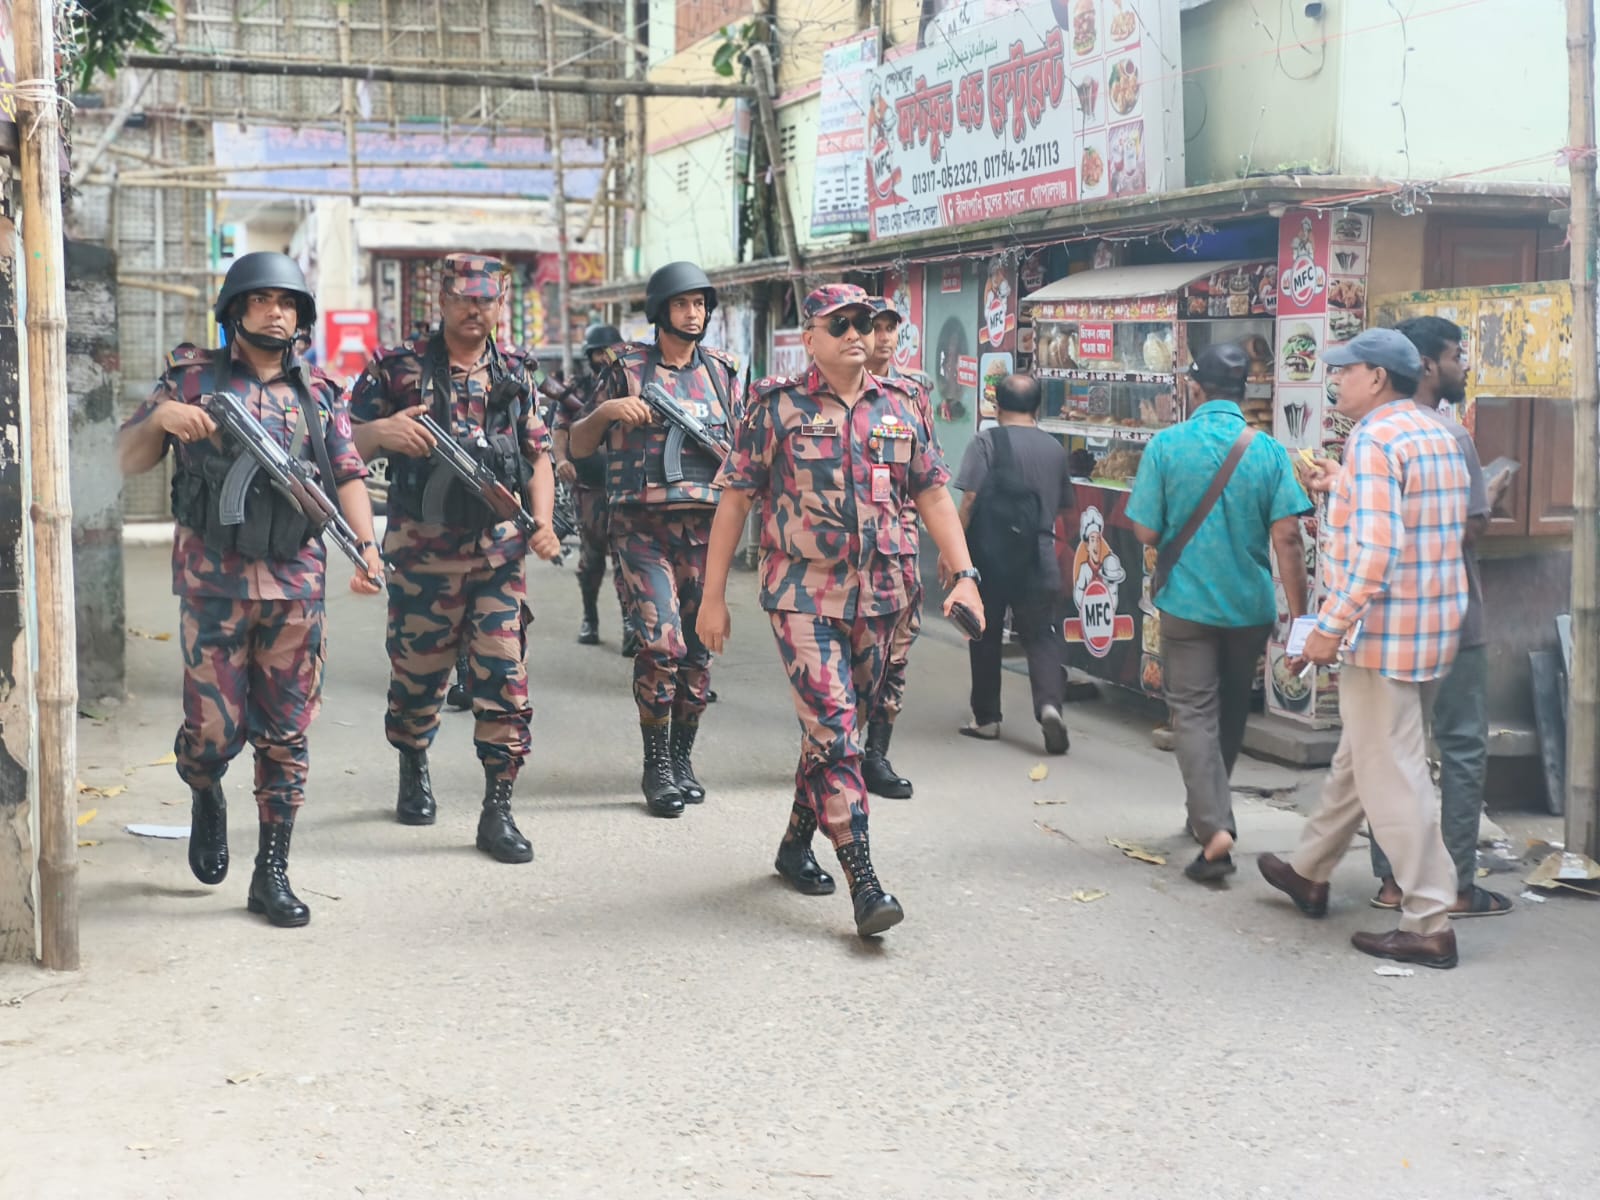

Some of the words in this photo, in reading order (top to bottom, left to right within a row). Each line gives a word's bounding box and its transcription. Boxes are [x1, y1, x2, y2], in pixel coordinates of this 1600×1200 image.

[984, 140, 1060, 179] 01794-247113
[1294, 266, 1314, 290] MFC
[990, 310, 1003, 330] MFC
[1085, 602, 1111, 627] MFC
